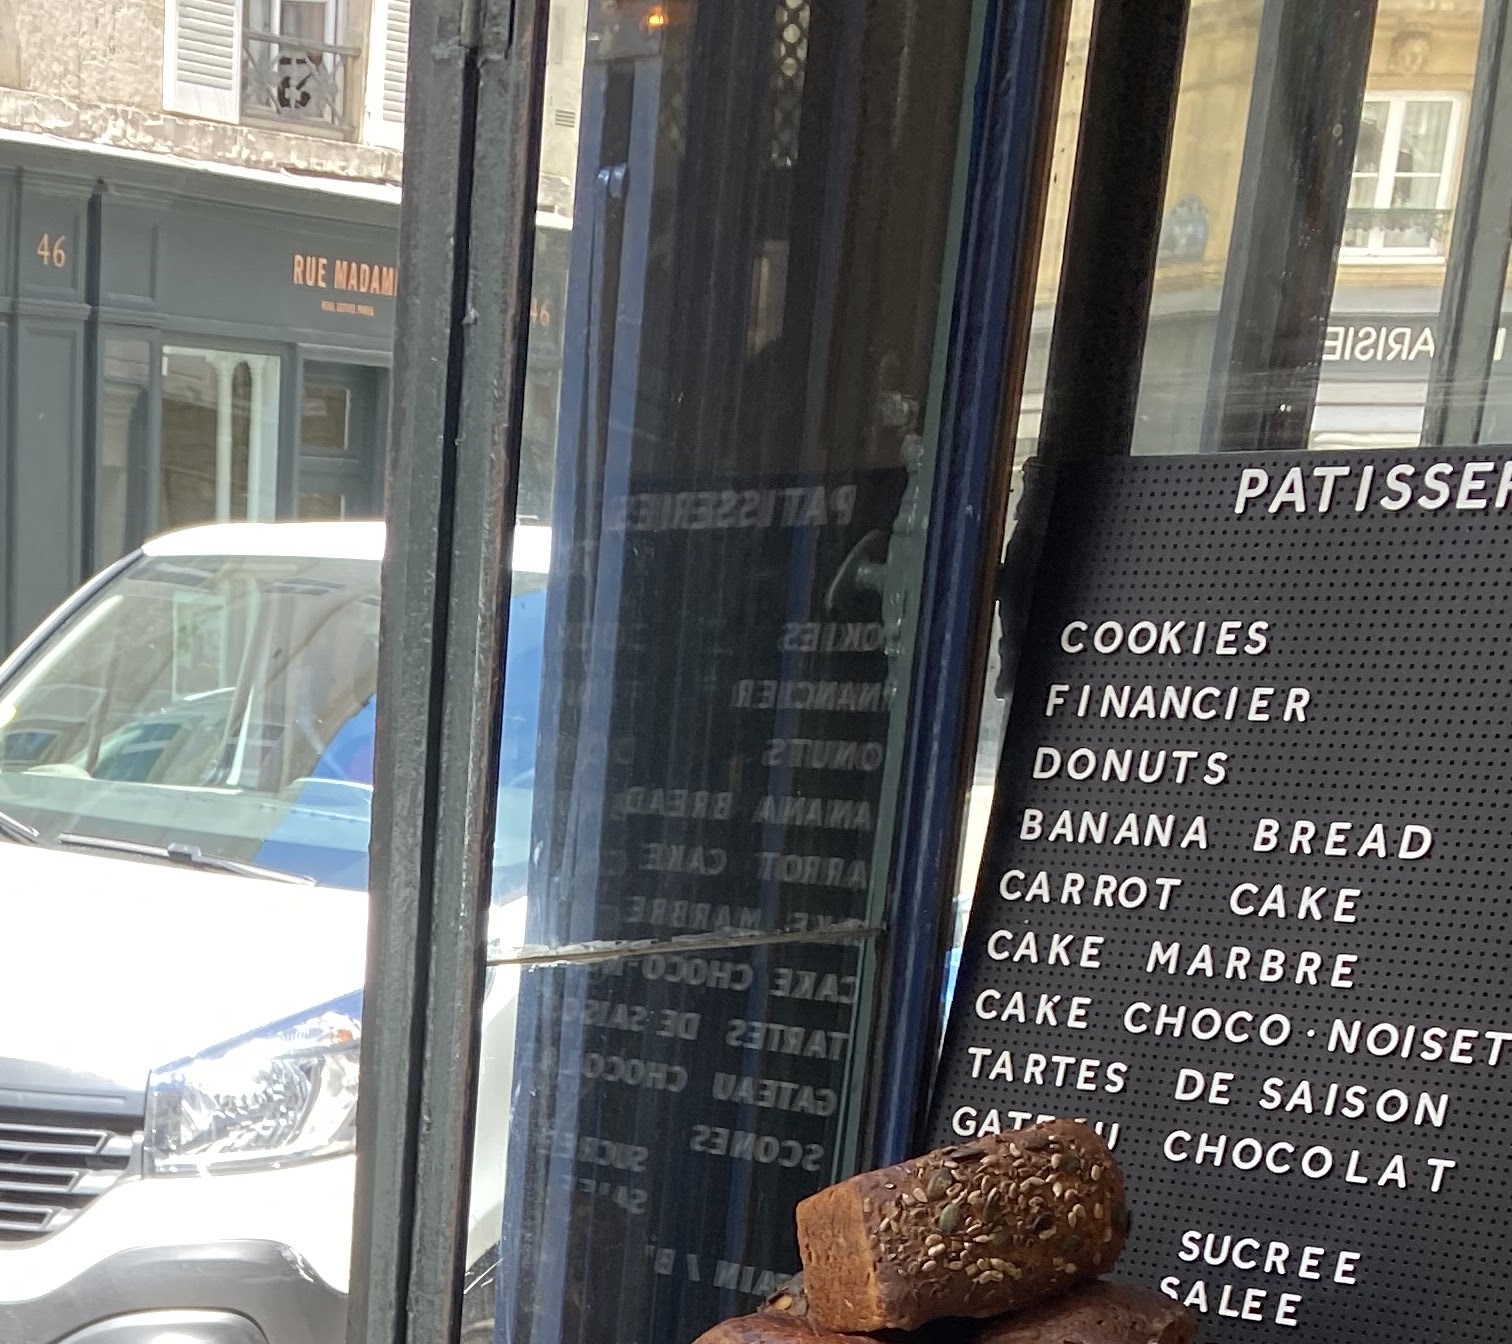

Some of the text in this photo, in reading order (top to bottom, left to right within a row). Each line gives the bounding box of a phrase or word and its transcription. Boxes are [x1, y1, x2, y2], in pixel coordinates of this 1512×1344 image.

[37, 233, 66, 268] 46
[293, 254, 398, 297] RUE MADAM
[1061, 620, 1269, 655] COOKIES
[1045, 684, 1311, 722] FINANCIER
[1032, 747, 1229, 786] DONUTS
[1019, 808, 1434, 861] BANANA BREAD
[999, 868, 1361, 924] CARROT CAKE
[987, 928, 1358, 989] CAKE MARBRE
[975, 988, 1092, 1030] CAKE
[968, 1046, 1449, 1128] TARTES DE SAISON
[951, 1106, 1457, 1194] GATU CHOCOLAT
[1178, 1230, 1361, 1286] SUCREE
[1160, 1276, 1303, 1327] SALEE
